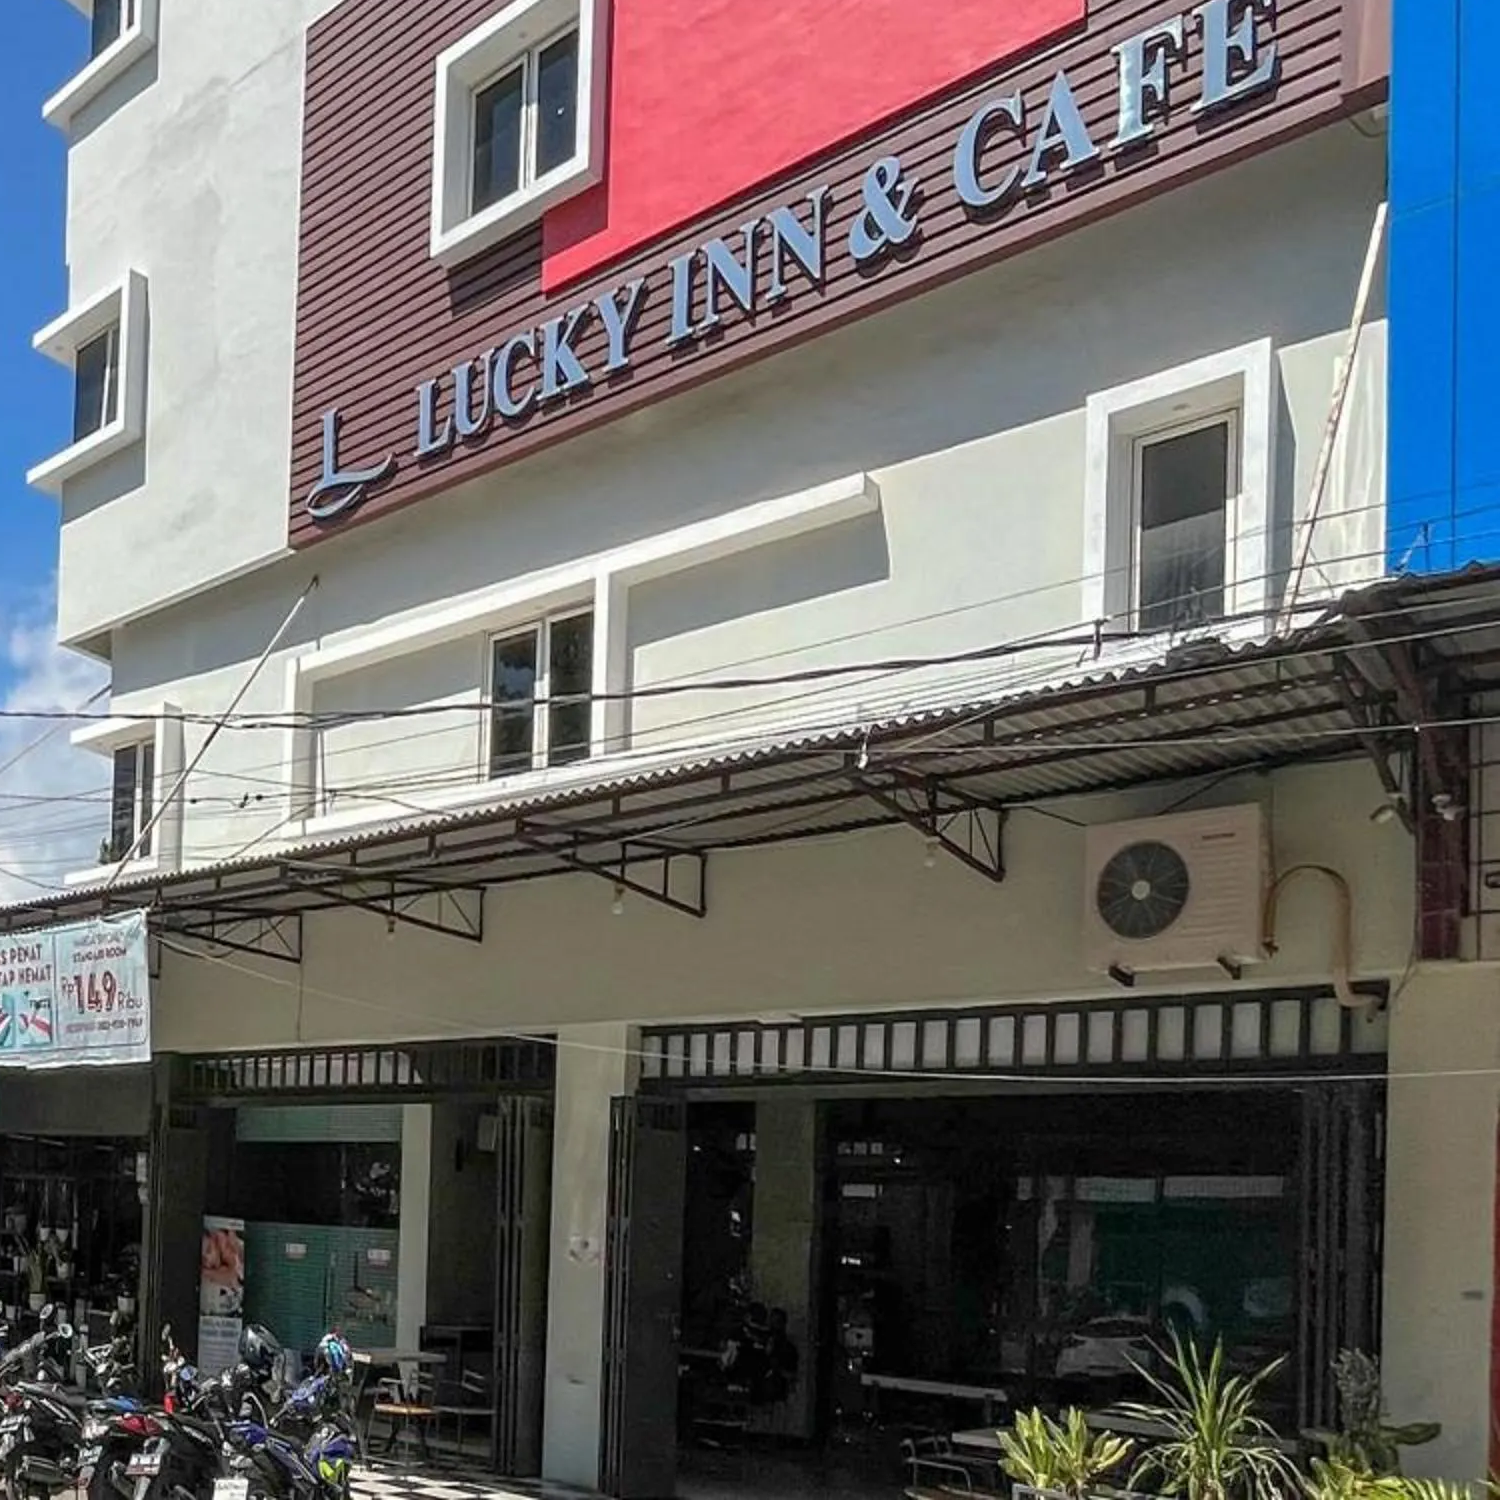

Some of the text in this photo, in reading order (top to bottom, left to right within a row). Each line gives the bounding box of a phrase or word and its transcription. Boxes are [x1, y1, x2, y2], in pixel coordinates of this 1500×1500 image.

[413, 277, 645, 457] LUCKY
[666, 184, 830, 346] INN
[850, 156, 919, 259] &
[18, 963, 52, 984] HEMAT
[74, 971, 117, 1014] 149
